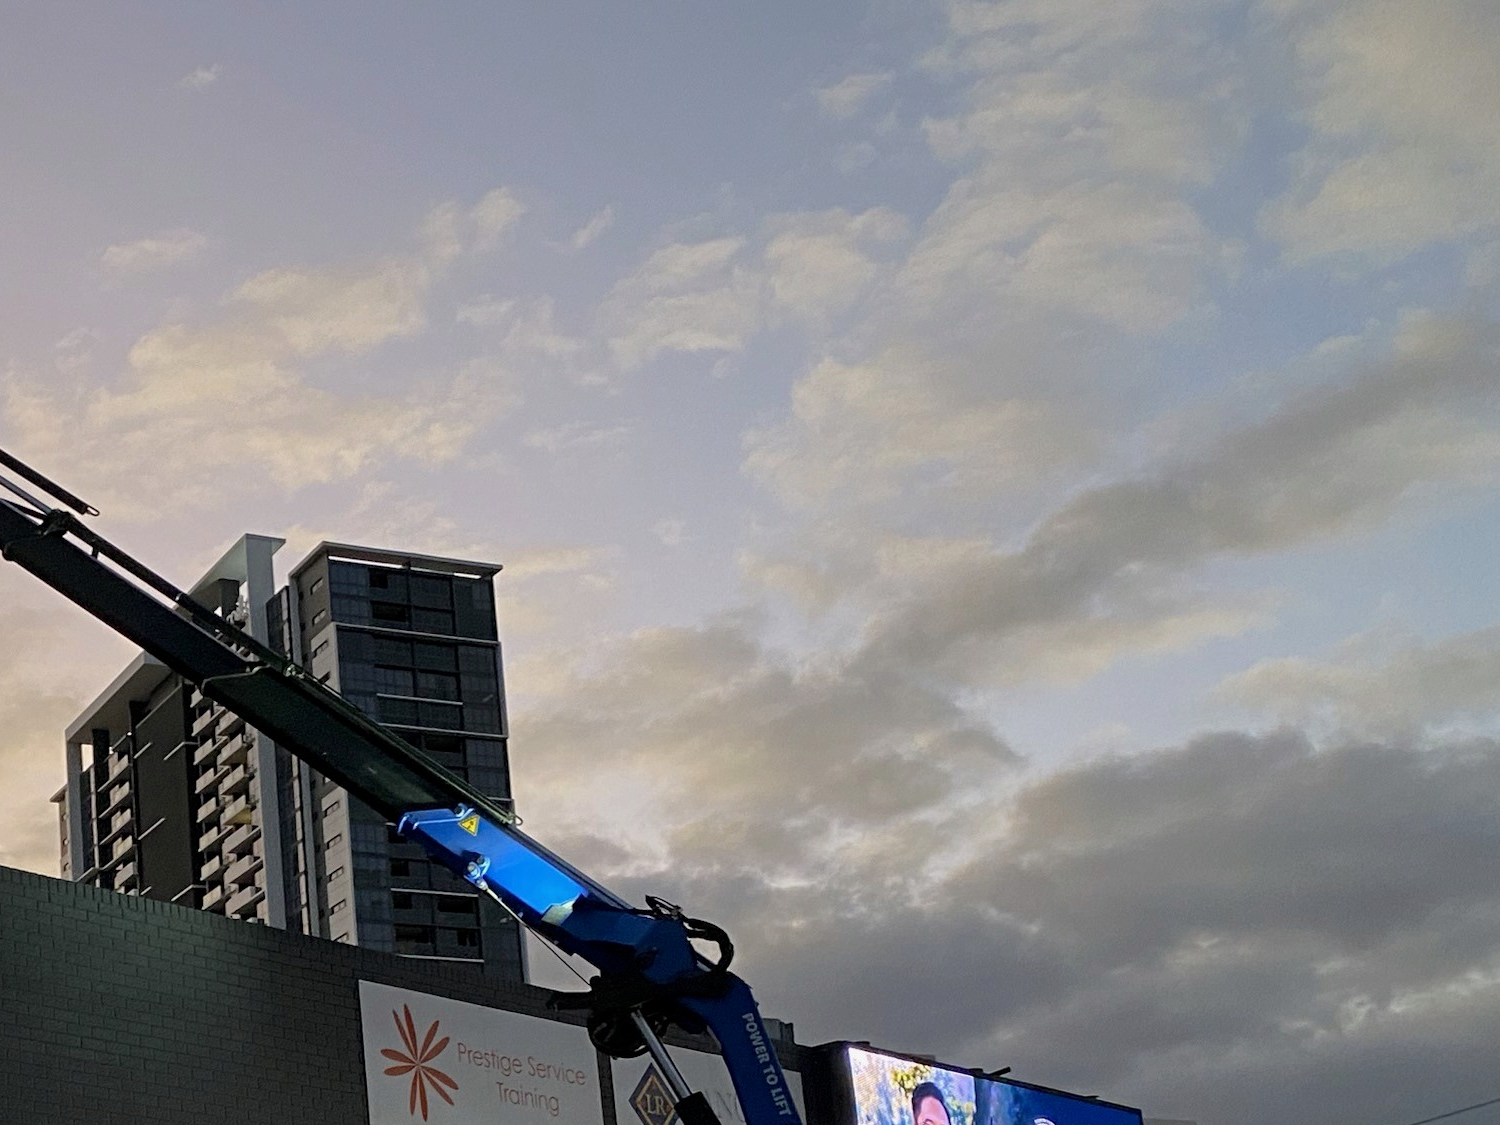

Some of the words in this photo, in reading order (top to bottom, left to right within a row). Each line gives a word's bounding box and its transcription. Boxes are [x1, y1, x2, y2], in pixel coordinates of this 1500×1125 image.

[457, 1042, 523, 1077] Prestige
[527, 1056, 587, 1086] Service
[742, 1012, 770, 1064] POWER
[763, 1064, 778, 1085] TO
[771, 1087, 792, 1117] LIFT
[496, 1081, 560, 1117] Training
[646, 1094, 667, 1116] LR
